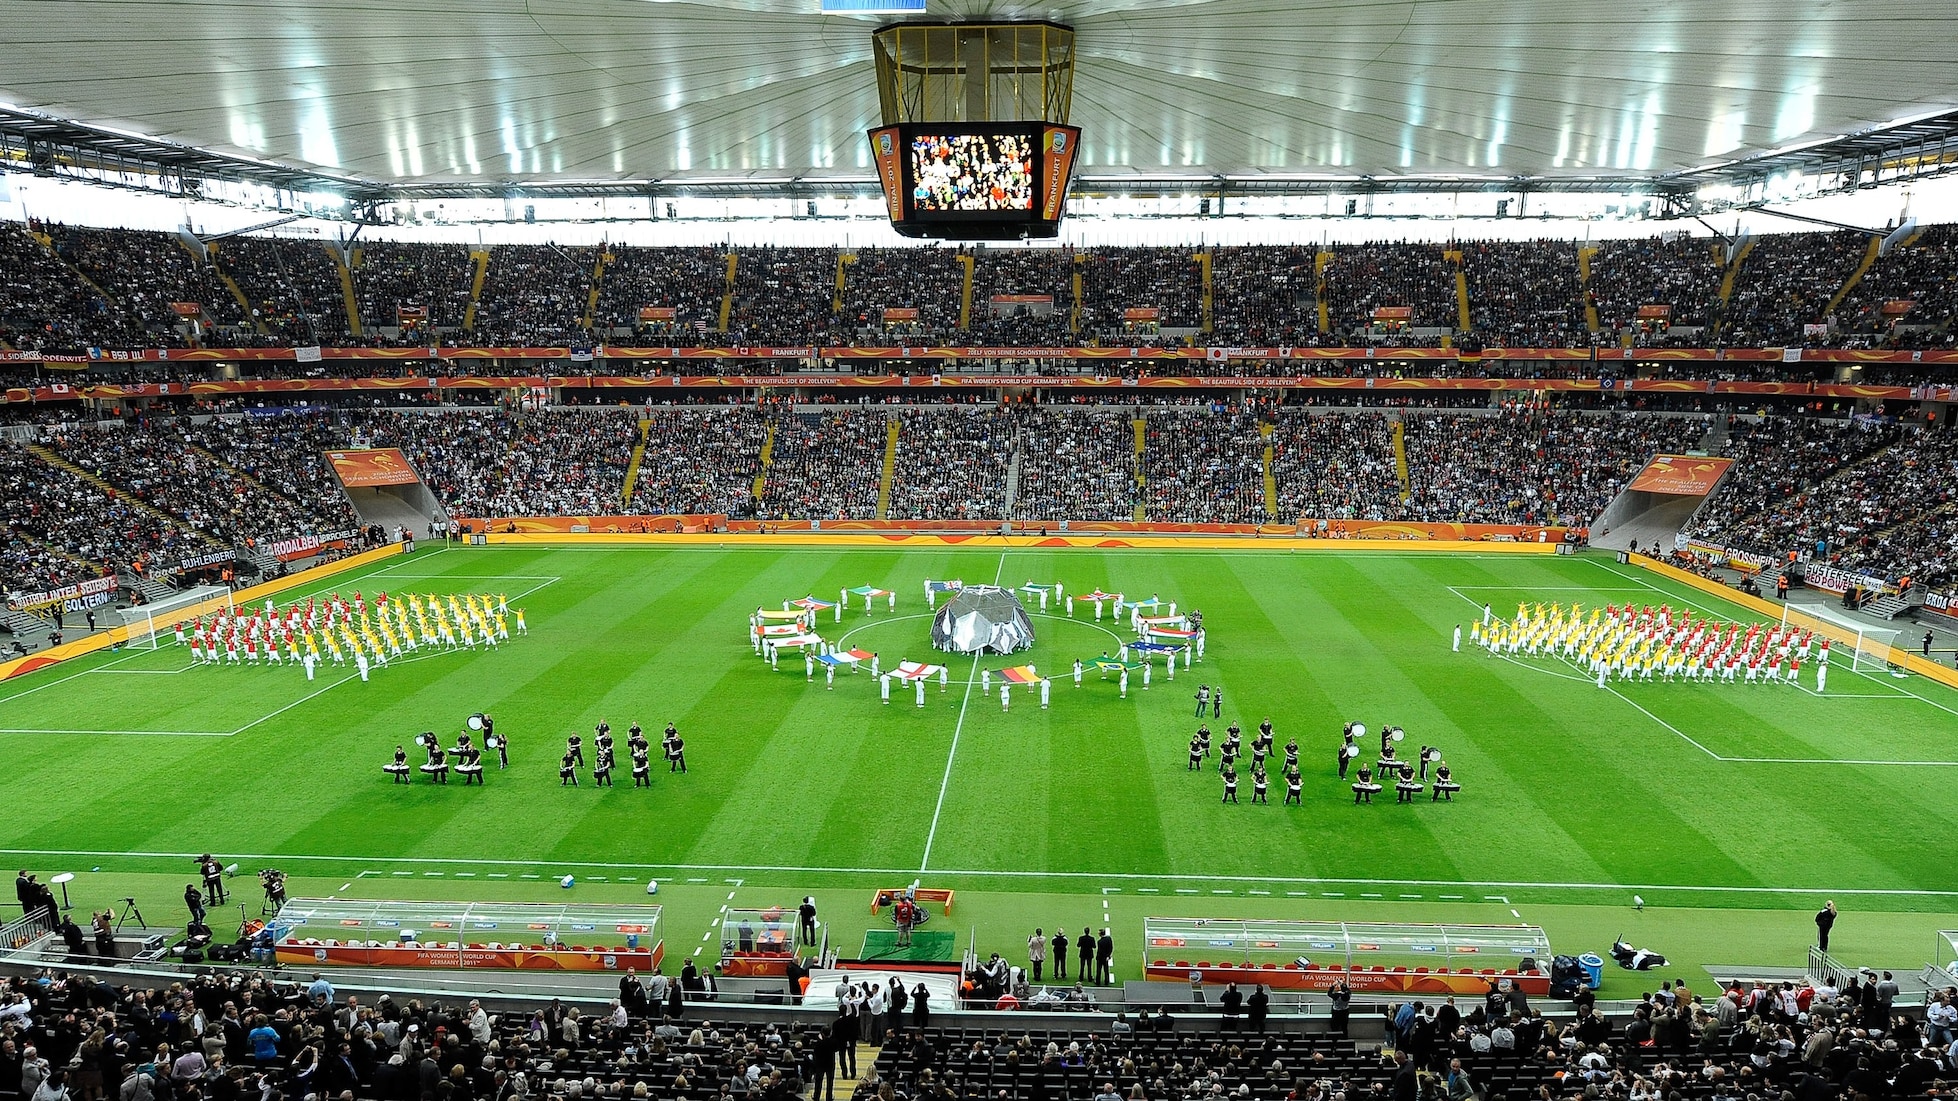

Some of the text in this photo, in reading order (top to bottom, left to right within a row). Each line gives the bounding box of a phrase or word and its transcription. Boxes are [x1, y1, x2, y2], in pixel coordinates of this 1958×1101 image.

[887, 160, 898, 212] FINAL 2011
[1048, 157, 1060, 213] FRANKFURT
[273, 535, 320, 555] RODALBEN
[181, 550, 236, 569] BUHLENBERG
[1805, 573, 1820, 584] RED
[63, 591, 108, 613] GOLTERN
